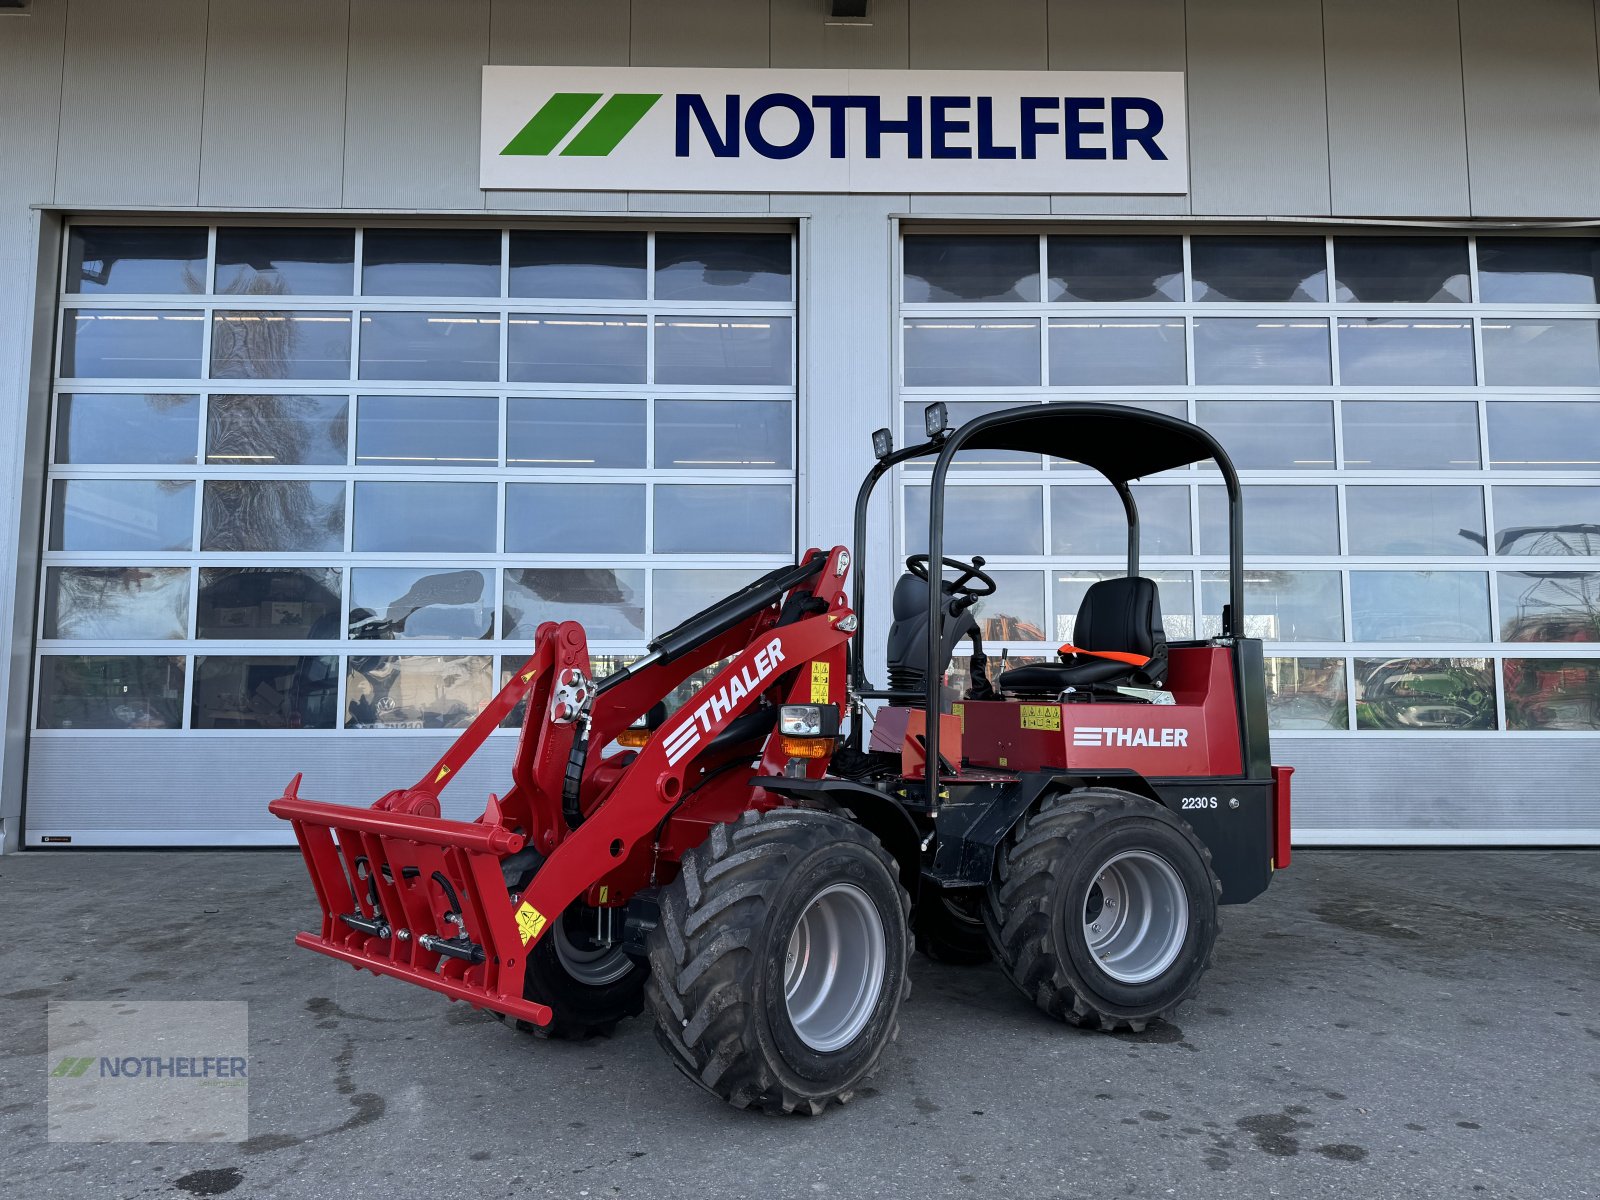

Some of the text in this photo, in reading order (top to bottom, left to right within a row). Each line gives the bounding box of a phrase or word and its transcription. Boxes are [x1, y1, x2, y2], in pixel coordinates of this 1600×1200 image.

[676, 93, 1166, 161] NOTHELFER
[694, 637, 786, 734] THALER
[1103, 727, 1189, 747] THALER
[1181, 796, 1218, 809] 2230 S
